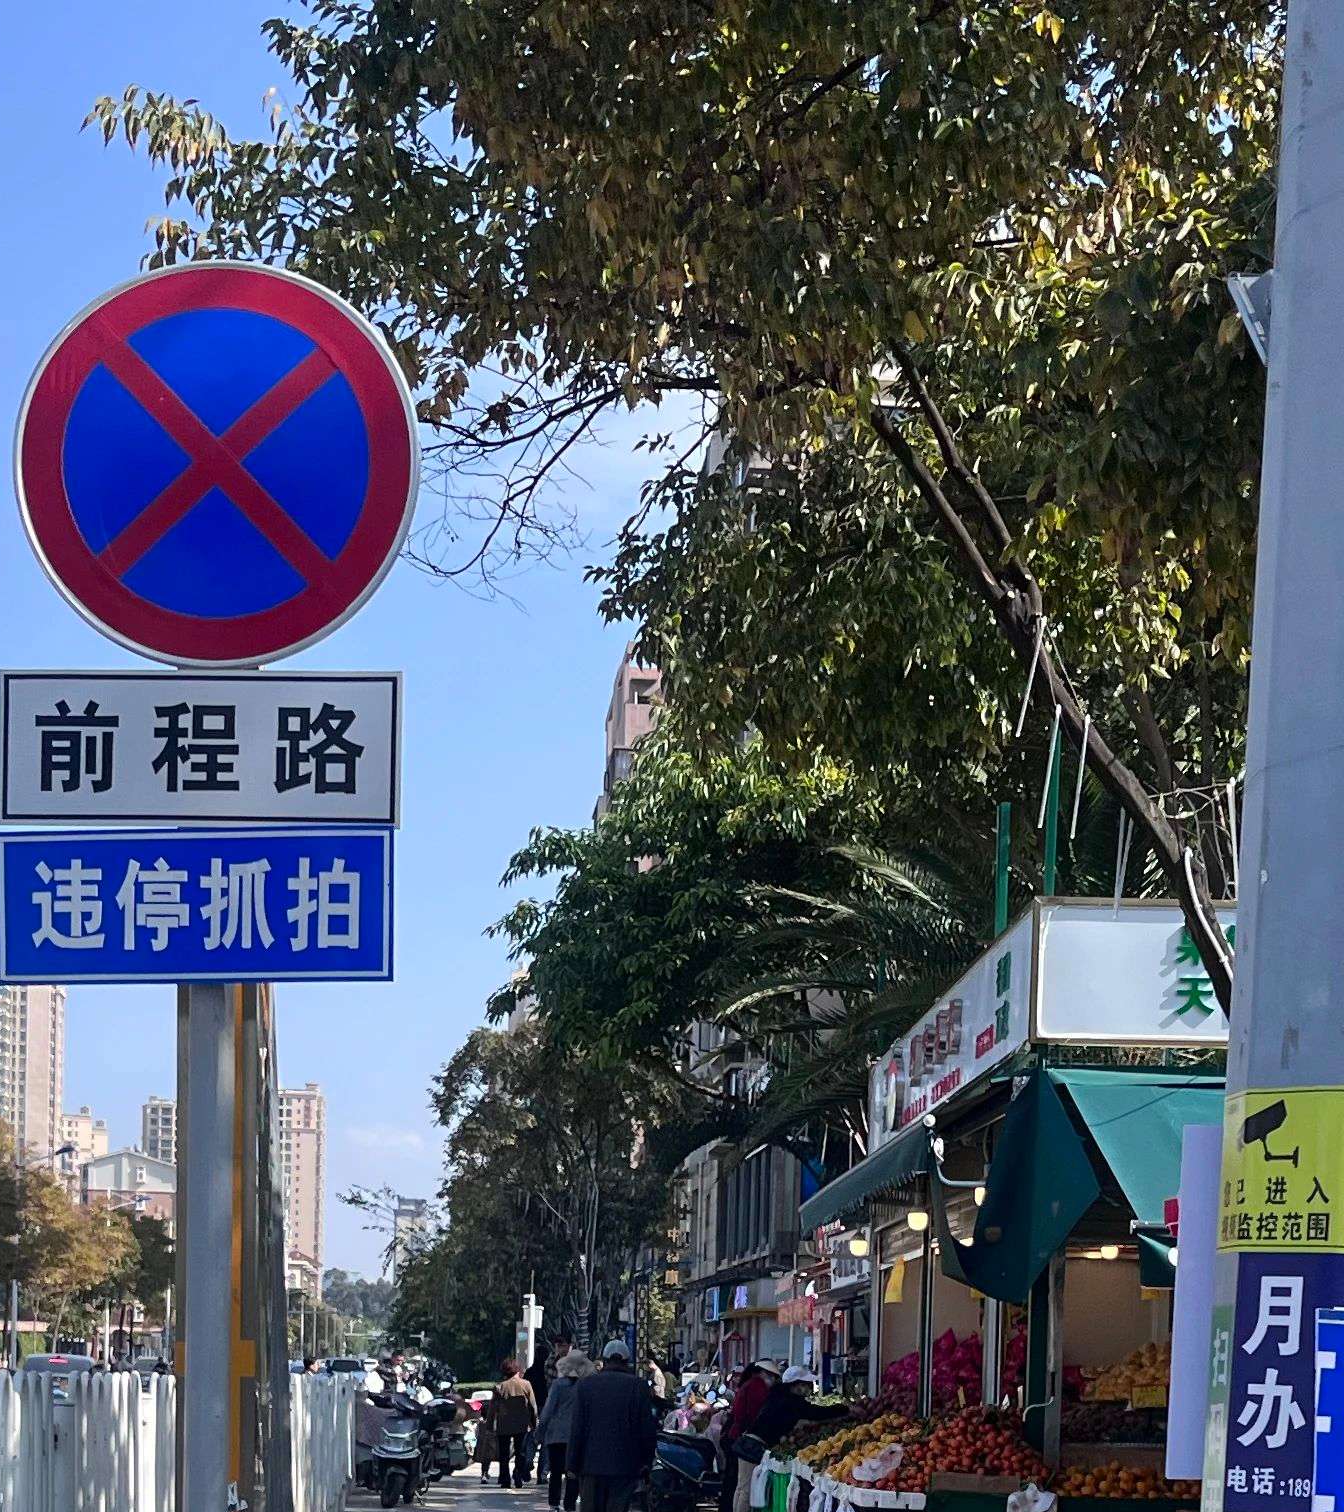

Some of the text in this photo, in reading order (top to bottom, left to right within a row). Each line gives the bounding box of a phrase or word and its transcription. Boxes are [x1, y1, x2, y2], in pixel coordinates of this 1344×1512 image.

[35, 700, 365, 794] 前程路
[31, 858, 360, 951] 违停抓拍
